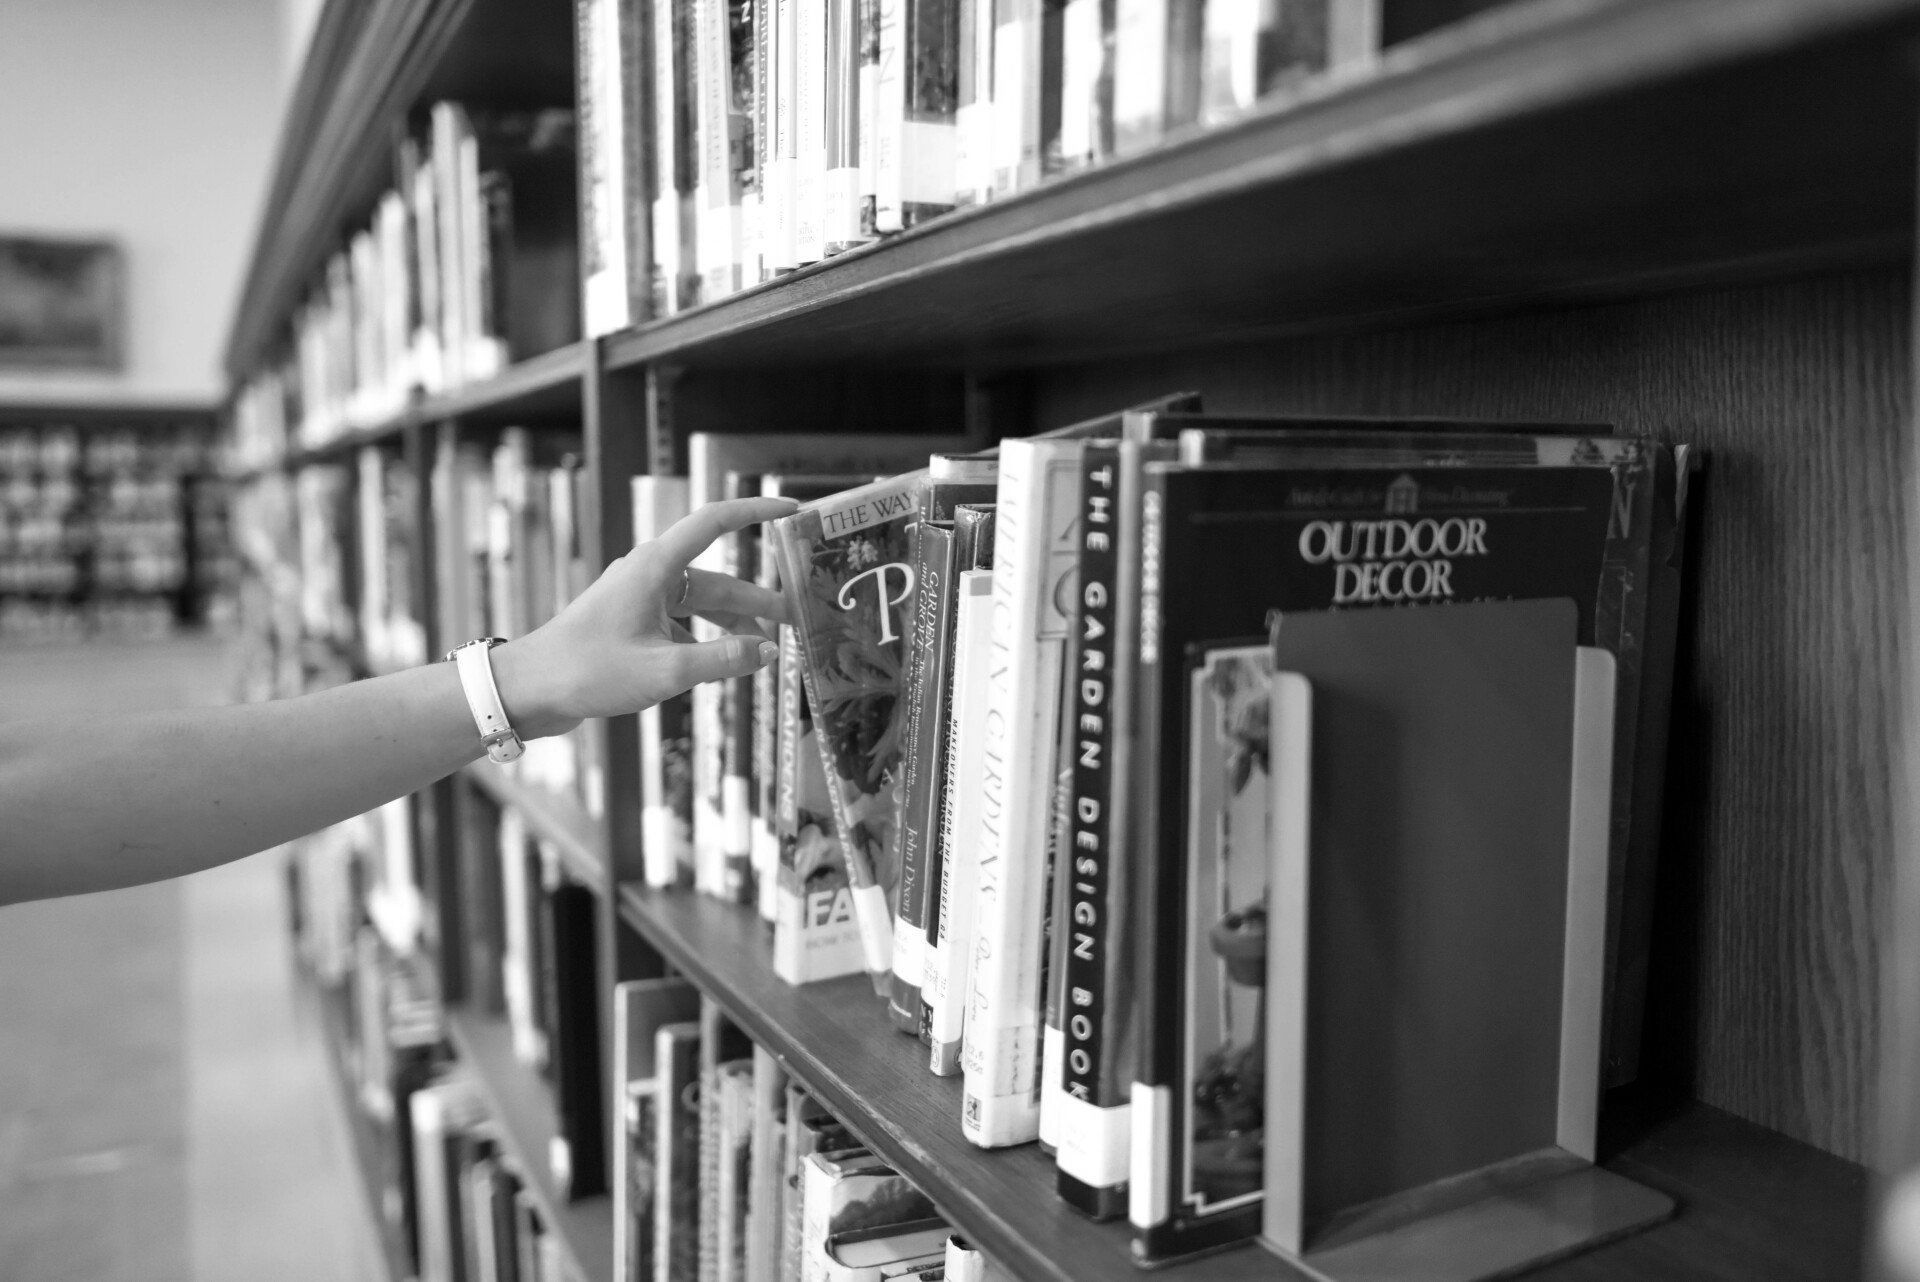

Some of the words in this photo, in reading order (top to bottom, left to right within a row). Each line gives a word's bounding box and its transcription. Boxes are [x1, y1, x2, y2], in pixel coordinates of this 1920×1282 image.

[823, 504, 868, 534] THE
[1086, 464, 1113, 553] THE
[1299, 517, 1488, 564] OUTDOOR
[838, 562, 916, 646] P
[918, 561, 928, 588] and
[1333, 559, 1455, 602] DECOR
[915, 589, 928, 653] GROVE
[923, 571, 940, 653] GARDEN
[1080, 581, 1109, 770] GARDEN
[781, 688, 797, 823] GARDENS
[948, 718, 959, 795] MAKEOVERS
[945, 800, 953, 835] FROM
[979, 707, 1005, 903] GARDENS
[904, 826, 918, 861] John
[943, 841, 951, 865] THE
[902, 867, 916, 914] Dixon
[940, 871, 950, 919] BUDGET
[1073, 796, 1101, 961] DESIGN
[1069, 986, 1094, 1102] BOOK
